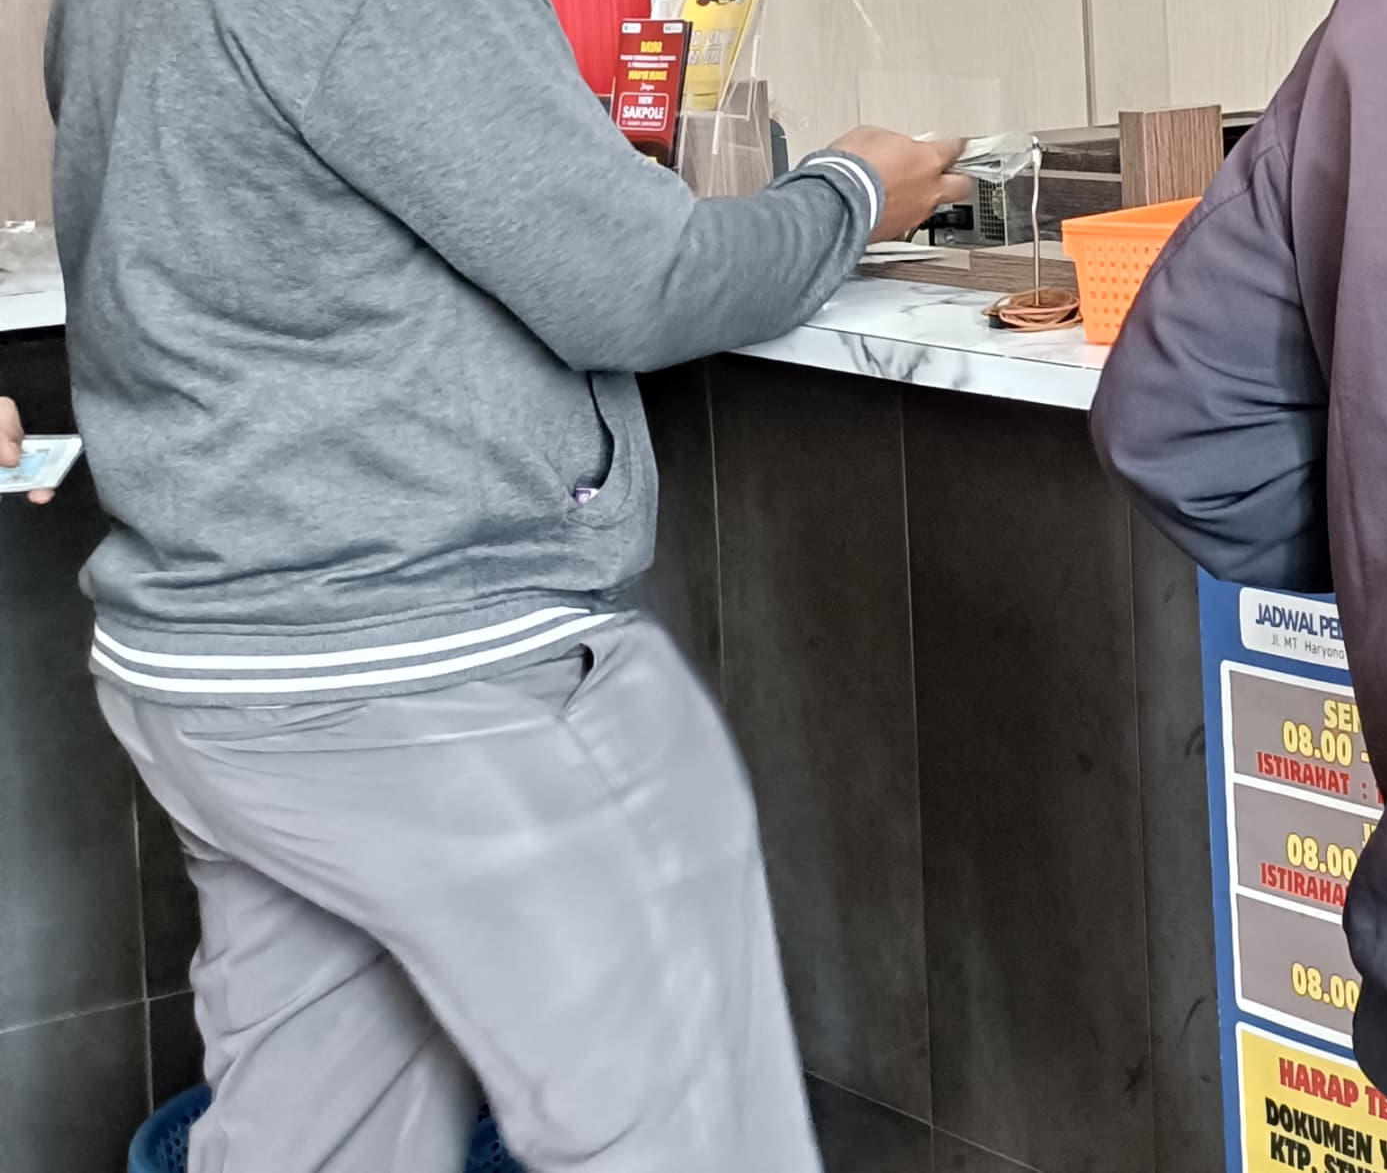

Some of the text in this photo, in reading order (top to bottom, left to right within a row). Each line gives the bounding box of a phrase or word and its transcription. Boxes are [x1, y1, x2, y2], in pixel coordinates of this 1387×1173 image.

[622, 105, 664, 120] SAKPOLE
[1255, 602, 1318, 636] JADWAL
[1283, 635, 1298, 650] MT
[1283, 719, 1354, 767] 08.00
[1256, 750, 1350, 796] ISTIRAHAT
[1285, 832, 1358, 881] 08.00
[1291, 962, 1360, 1013] 08.00
[1278, 1057, 1359, 1108] HARAP
[1265, 1095, 1373, 1165] DOKUMEN
